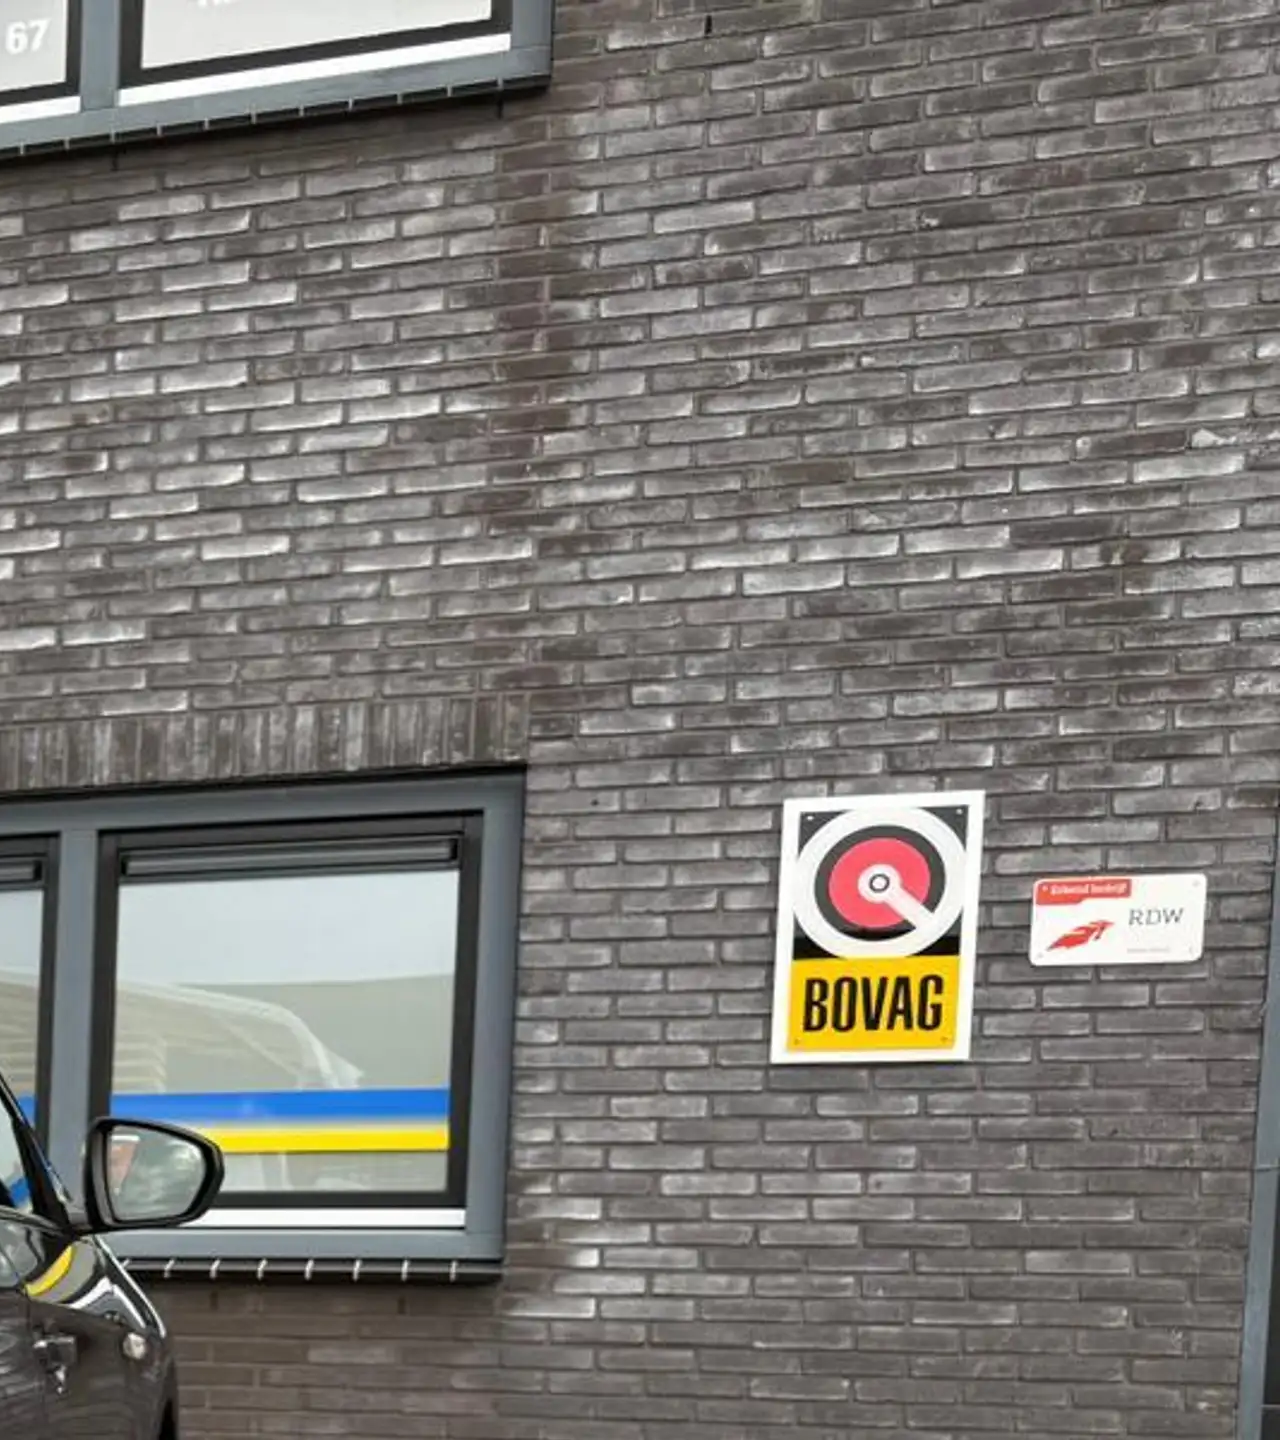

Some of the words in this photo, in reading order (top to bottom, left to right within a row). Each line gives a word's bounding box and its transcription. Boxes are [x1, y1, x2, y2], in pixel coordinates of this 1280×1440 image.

[5, 19, 51, 54] 67
[1128, 908, 1184, 926] RDW
[802, 974, 945, 1032] BOVAG
